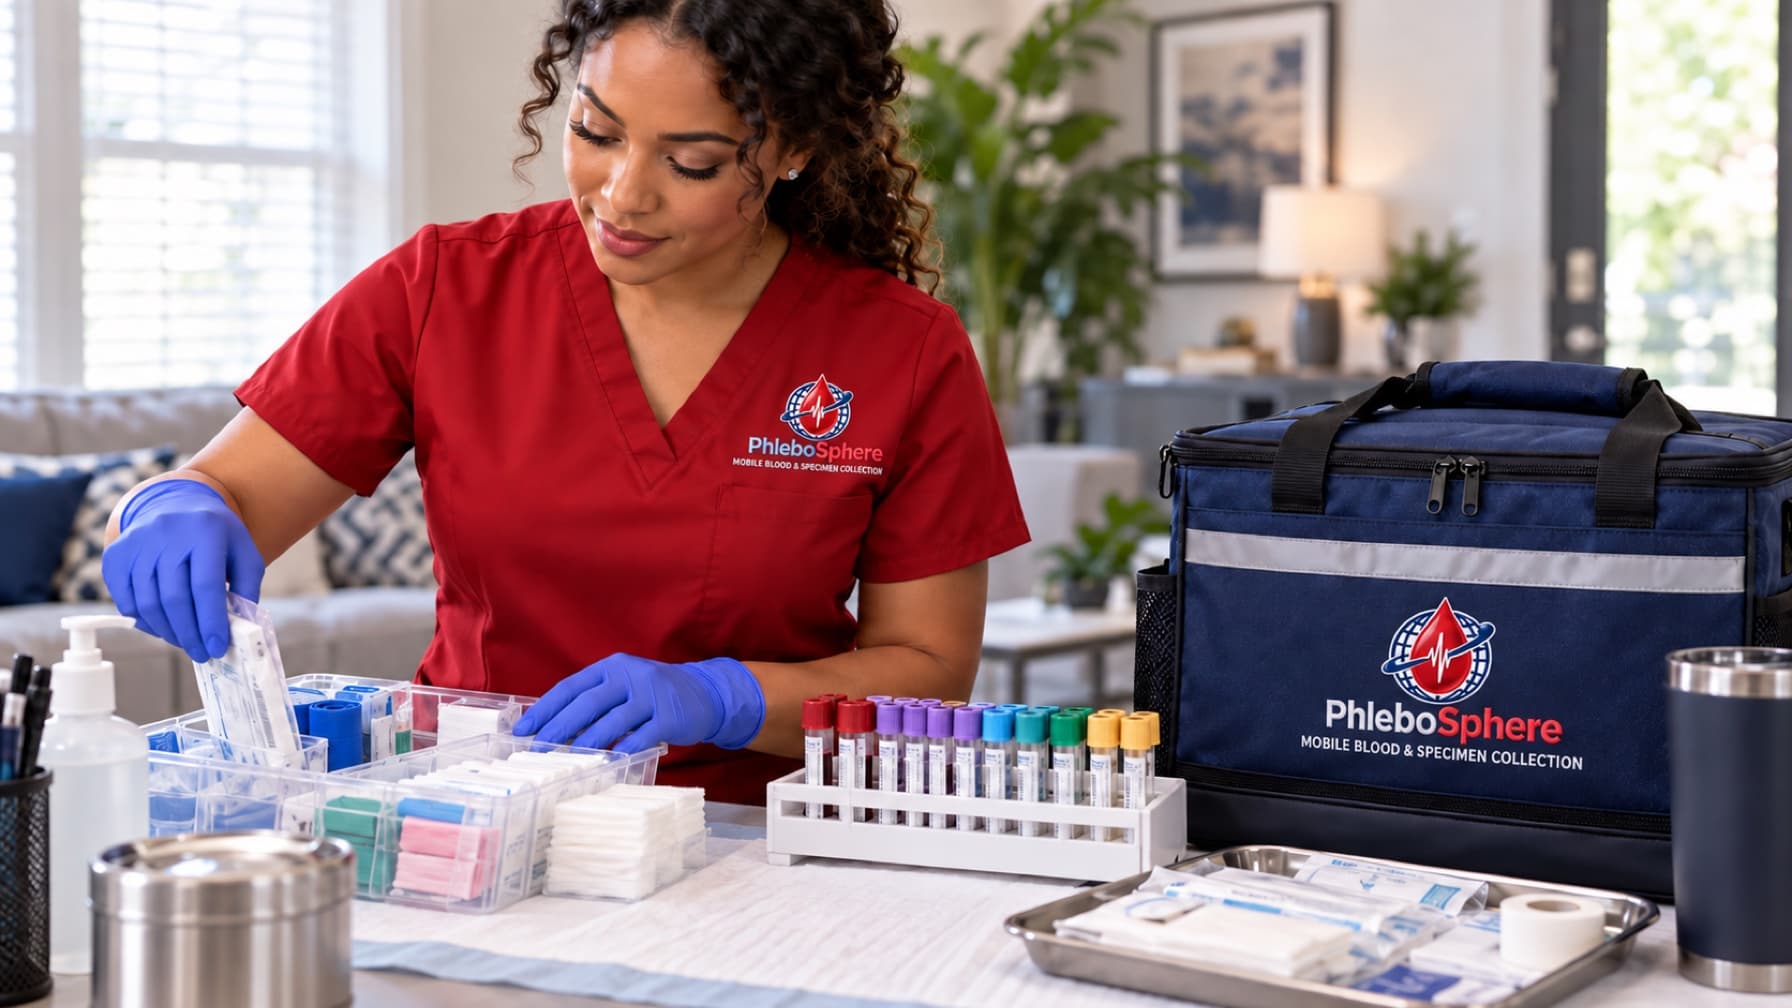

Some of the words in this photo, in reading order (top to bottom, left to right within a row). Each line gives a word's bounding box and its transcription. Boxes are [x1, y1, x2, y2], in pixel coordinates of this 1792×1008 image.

[748, 436, 883, 463] PhleboSphere
[732, 457, 763, 467] MOBILE
[764, 460, 791, 470] BLOOD
[800, 463, 839, 473] SPECIMEN
[839, 465, 883, 476] COLLECTION
[1325, 698, 1563, 745] PhleboSphere
[1301, 735, 1350, 752] MOBILE
[1354, 739, 1401, 757] BLOOD
[1403, 744, 1414, 757] &
[1416, 745, 1487, 764] SPECIMEN
[1491, 750, 1584, 771] COLLECTION
